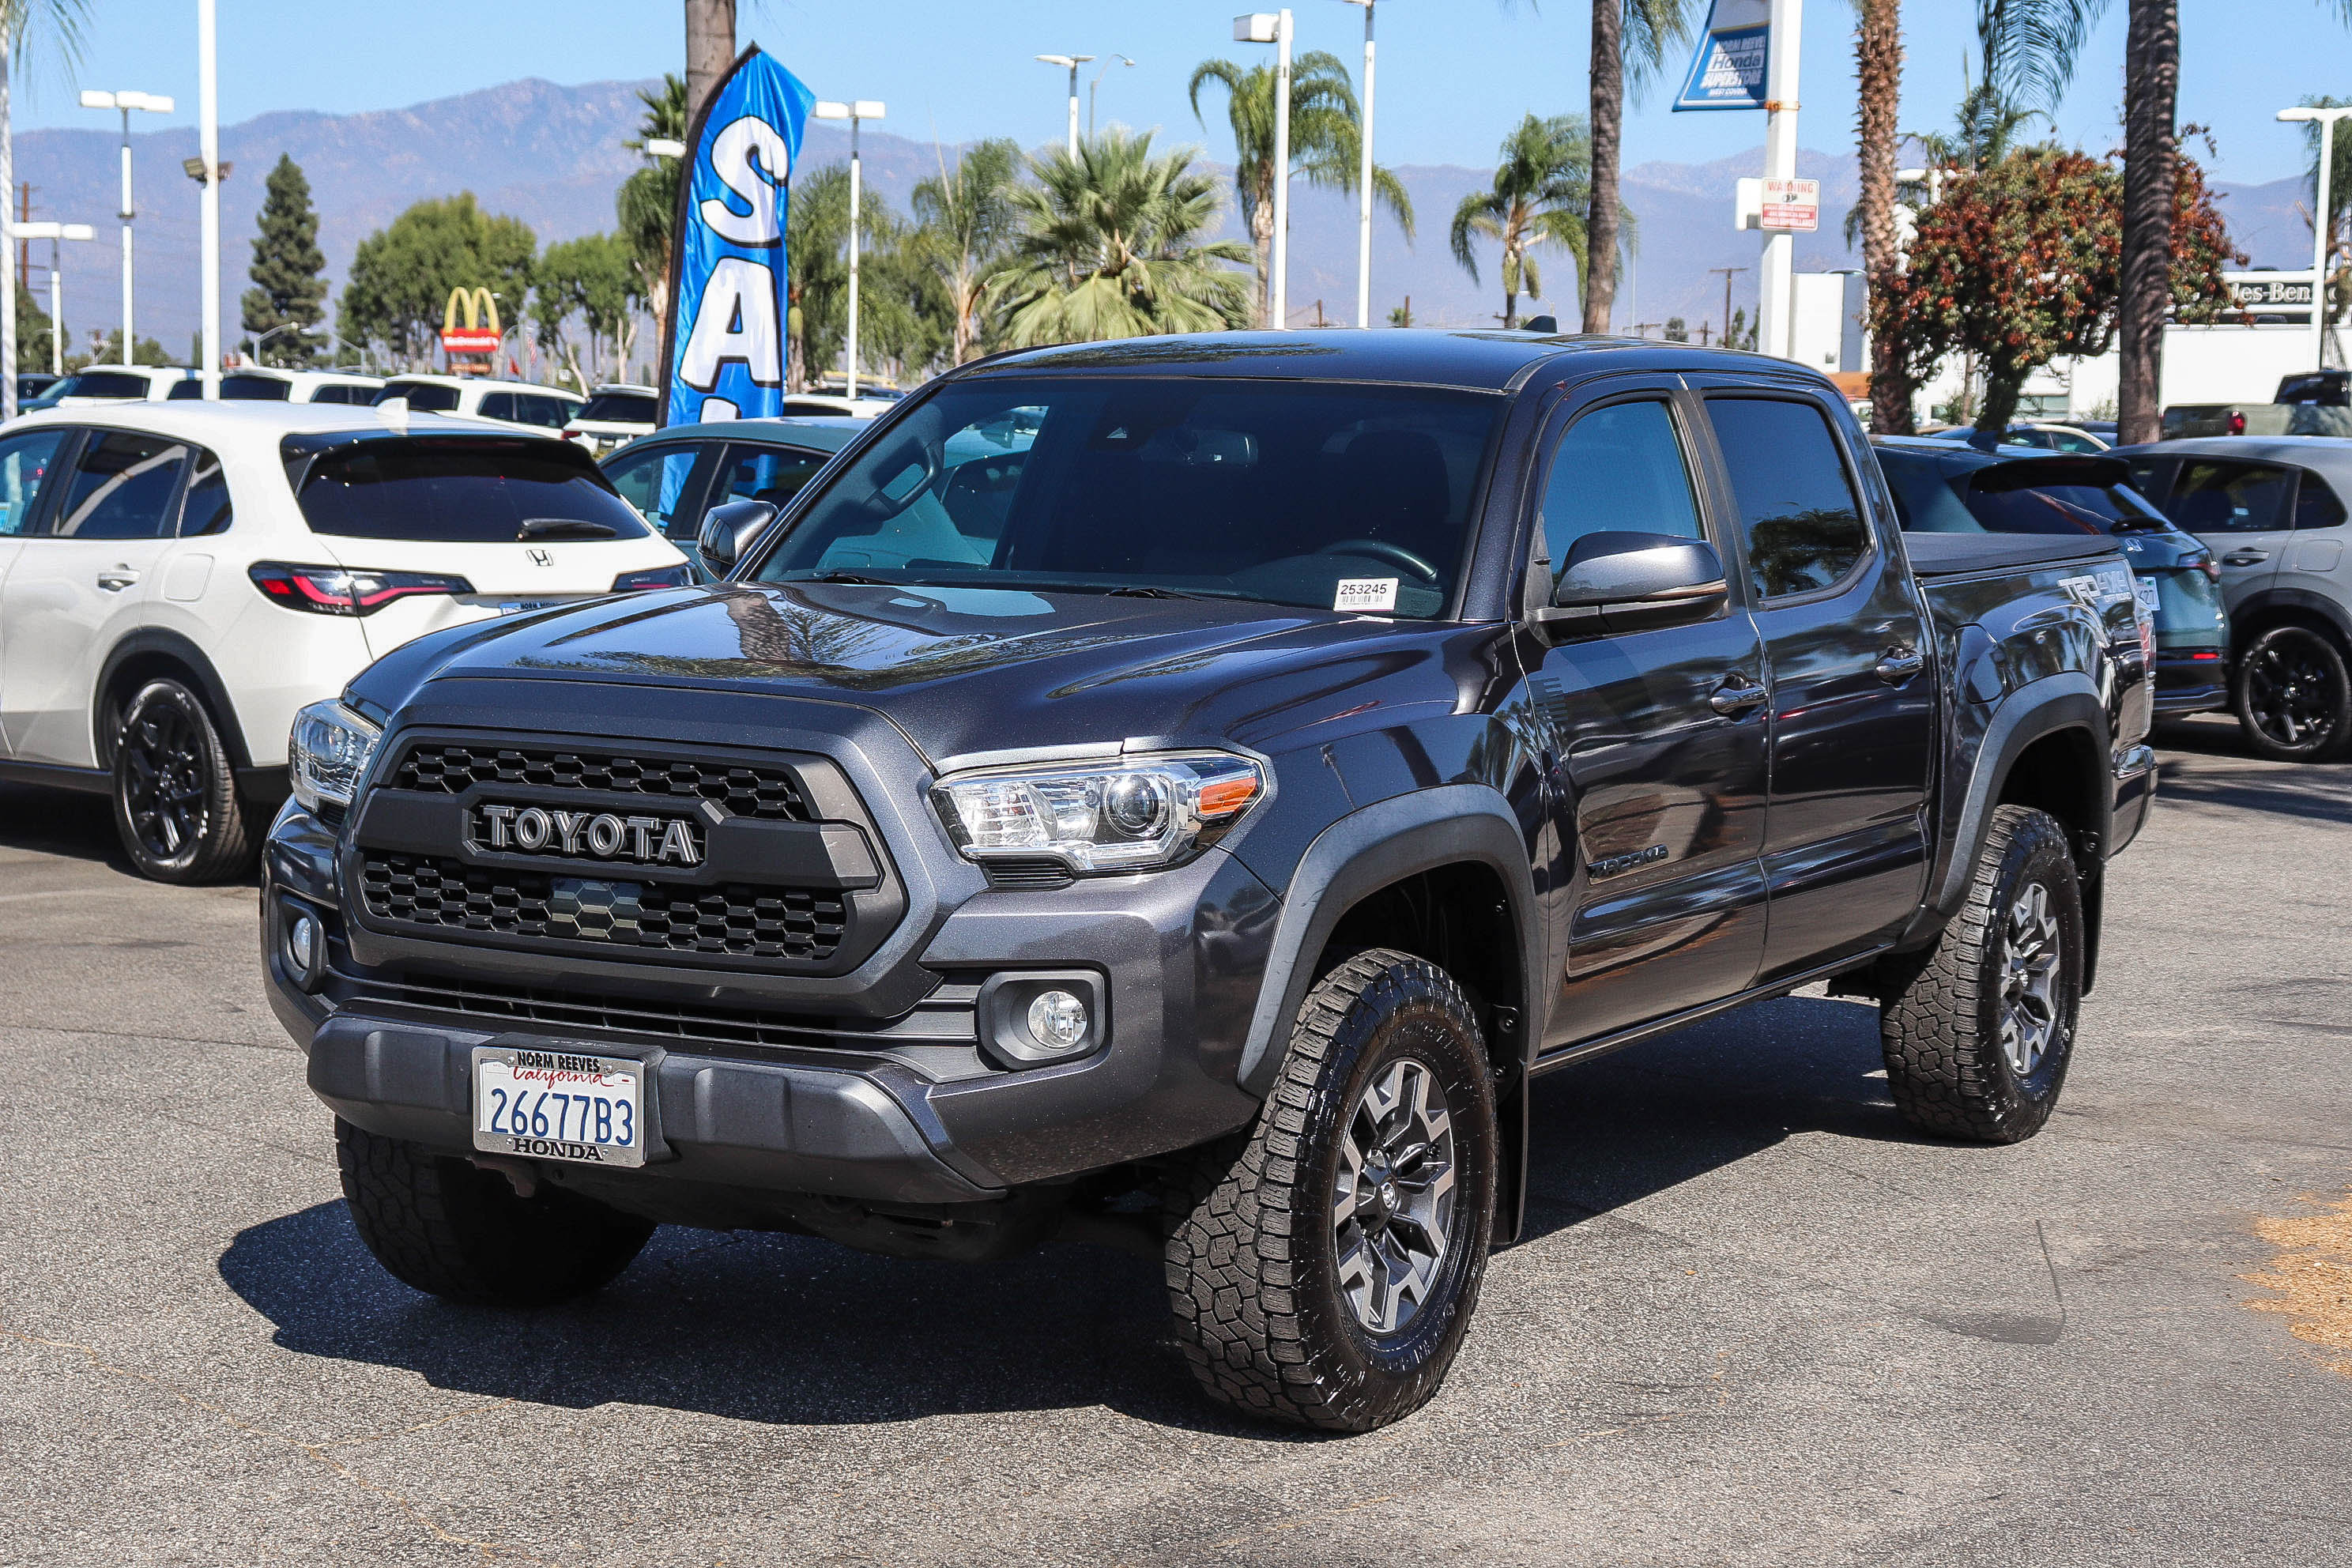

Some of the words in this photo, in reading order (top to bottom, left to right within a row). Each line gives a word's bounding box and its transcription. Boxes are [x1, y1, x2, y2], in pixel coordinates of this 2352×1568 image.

[1713, 52, 1761, 70] Honda
[1701, 70, 1763, 89] SUPERSTORE
[1340, 584, 1388, 594] 253245
[2056, 575, 2101, 605] TRD
[480, 805, 699, 863] TOYOTA
[1587, 844, 1669, 878] TACOMA
[517, 1050, 552, 1069] NORM
[558, 1054, 601, 1072] REEVES
[513, 1066, 614, 1089] California
[491, 1087, 633, 1146] 26677B3
[513, 1137, 604, 1161] HONDA
